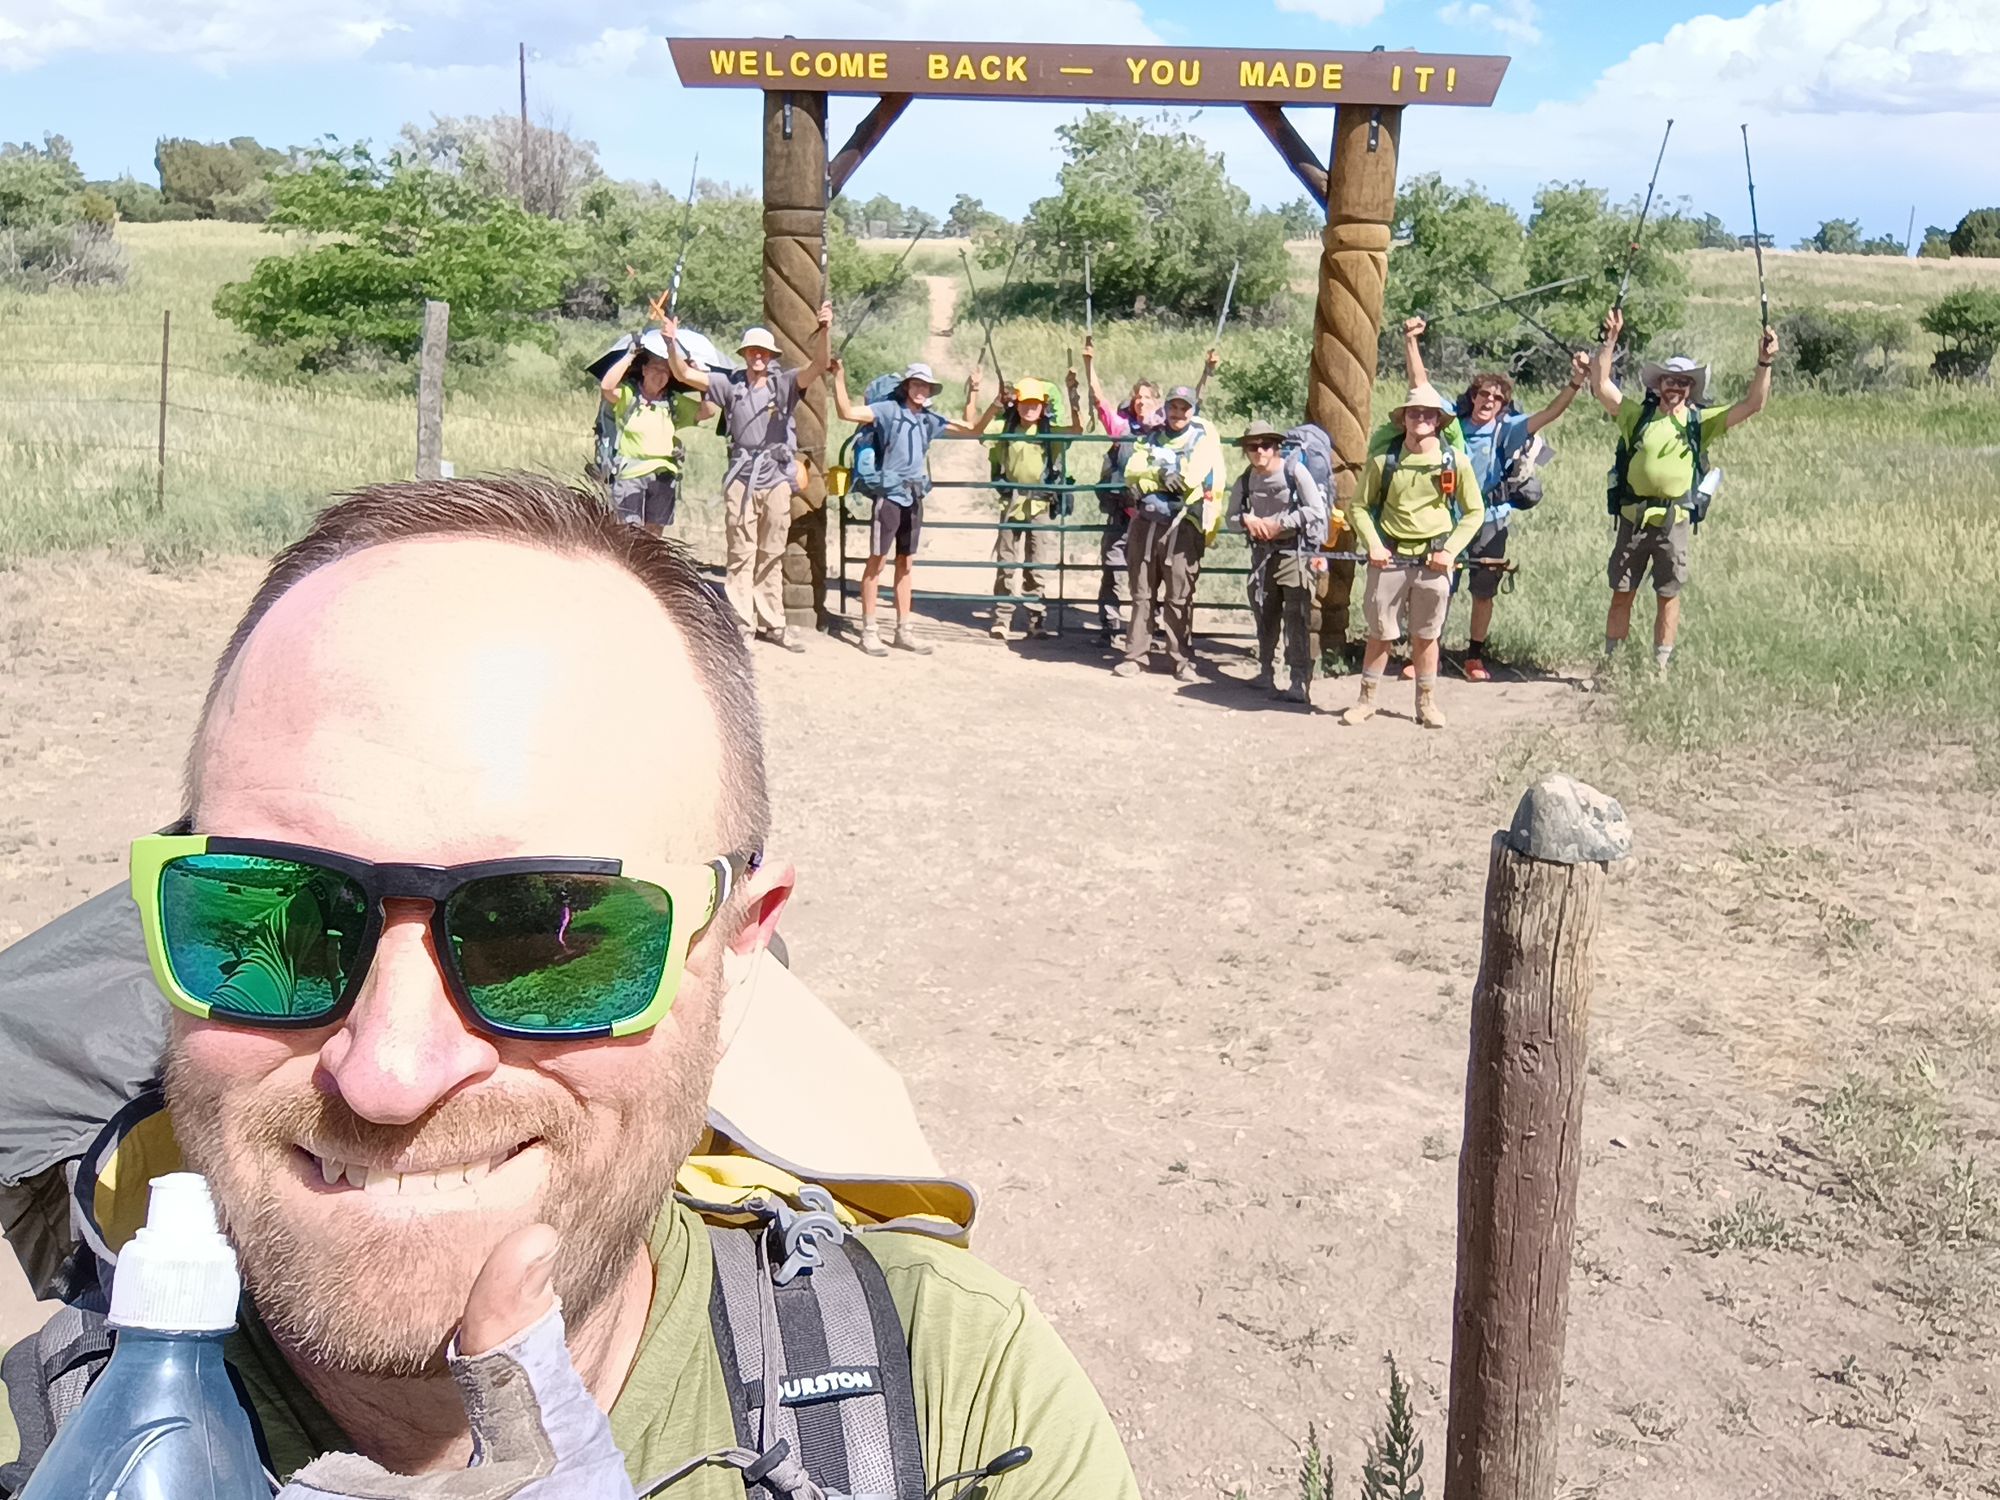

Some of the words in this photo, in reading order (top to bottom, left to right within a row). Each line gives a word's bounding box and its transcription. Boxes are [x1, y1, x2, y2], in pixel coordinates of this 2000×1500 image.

[710, 49, 888, 79] WELCOME
[927, 53, 1028, 82] BACK
[1127, 58, 1201, 87] YOU
[1239, 61, 1343, 90] MADE
[1392, 65, 1456, 93] IT!
